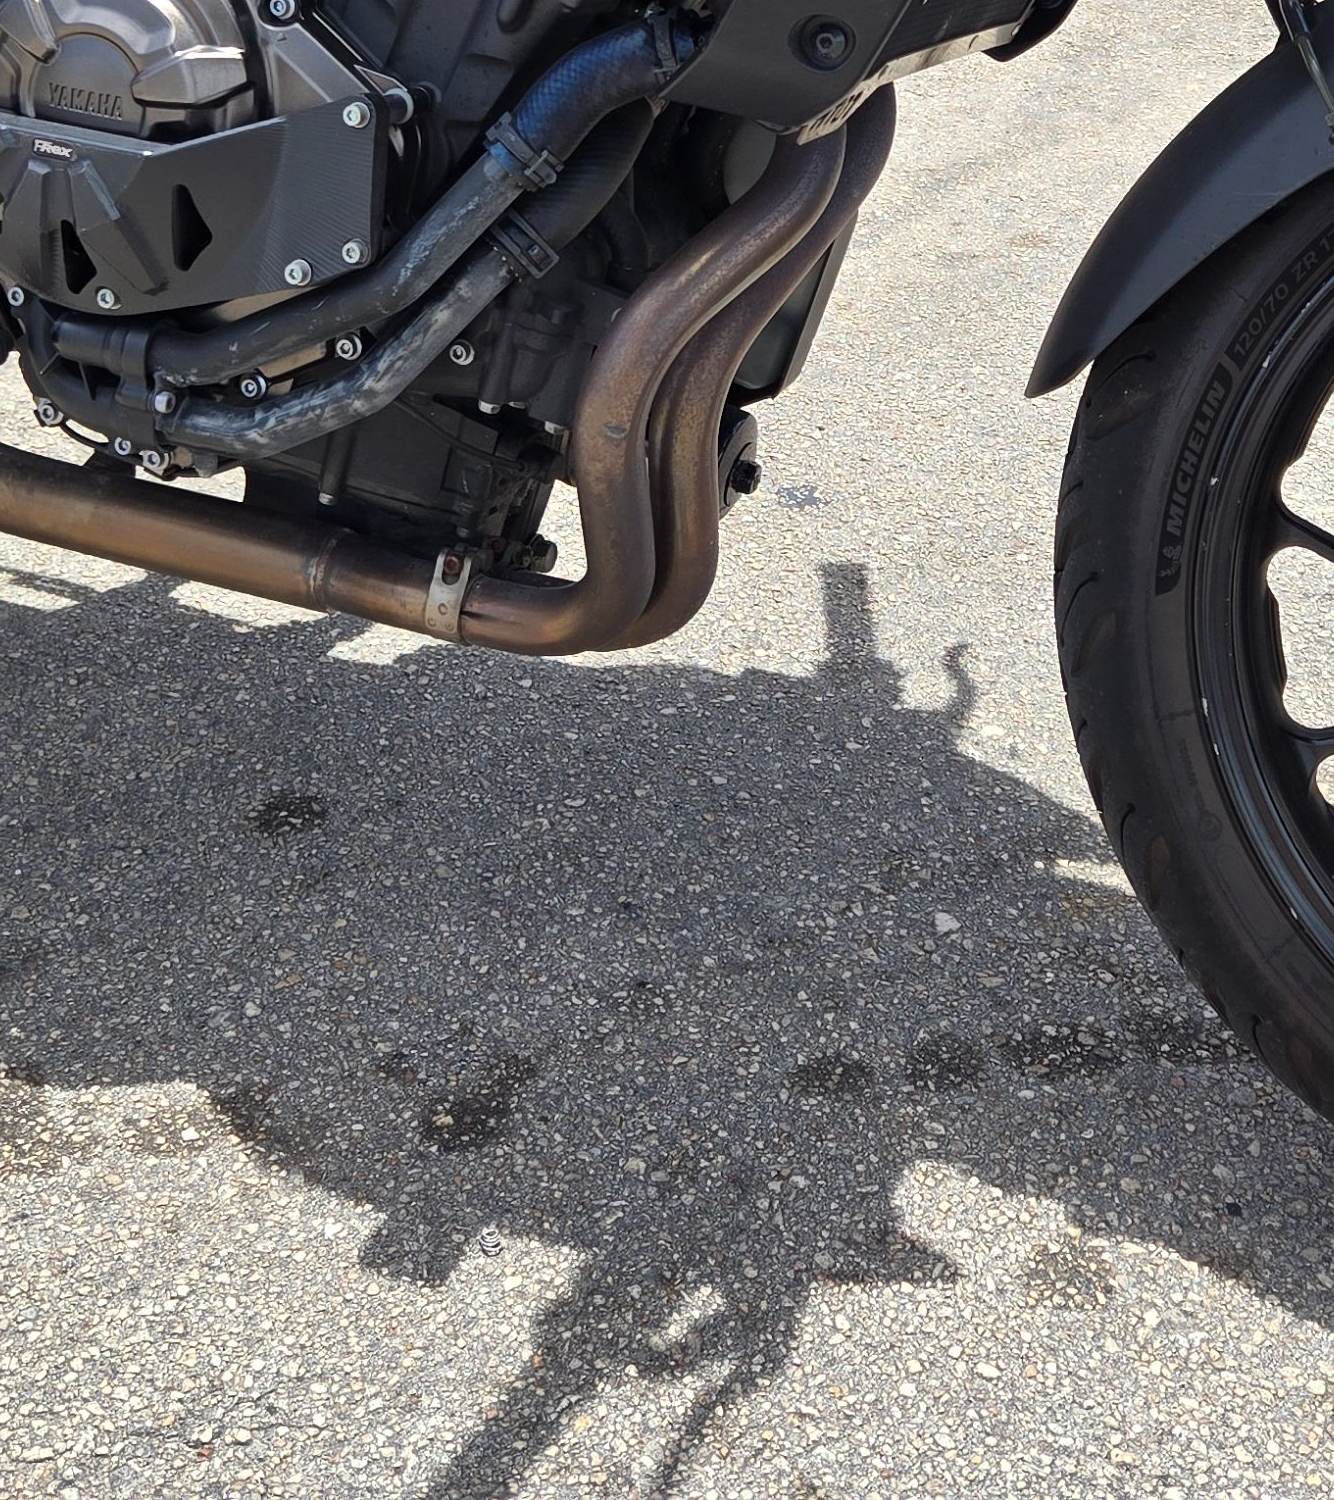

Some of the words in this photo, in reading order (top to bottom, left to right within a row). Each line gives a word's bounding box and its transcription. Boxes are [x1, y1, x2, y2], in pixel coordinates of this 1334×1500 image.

[48, 82, 123, 121] YAMAHA
[1167, 377, 1227, 537] MICHELIN
[1233, 282, 1289, 357] 120/70
[1290, 252, 1319, 286] ZR
